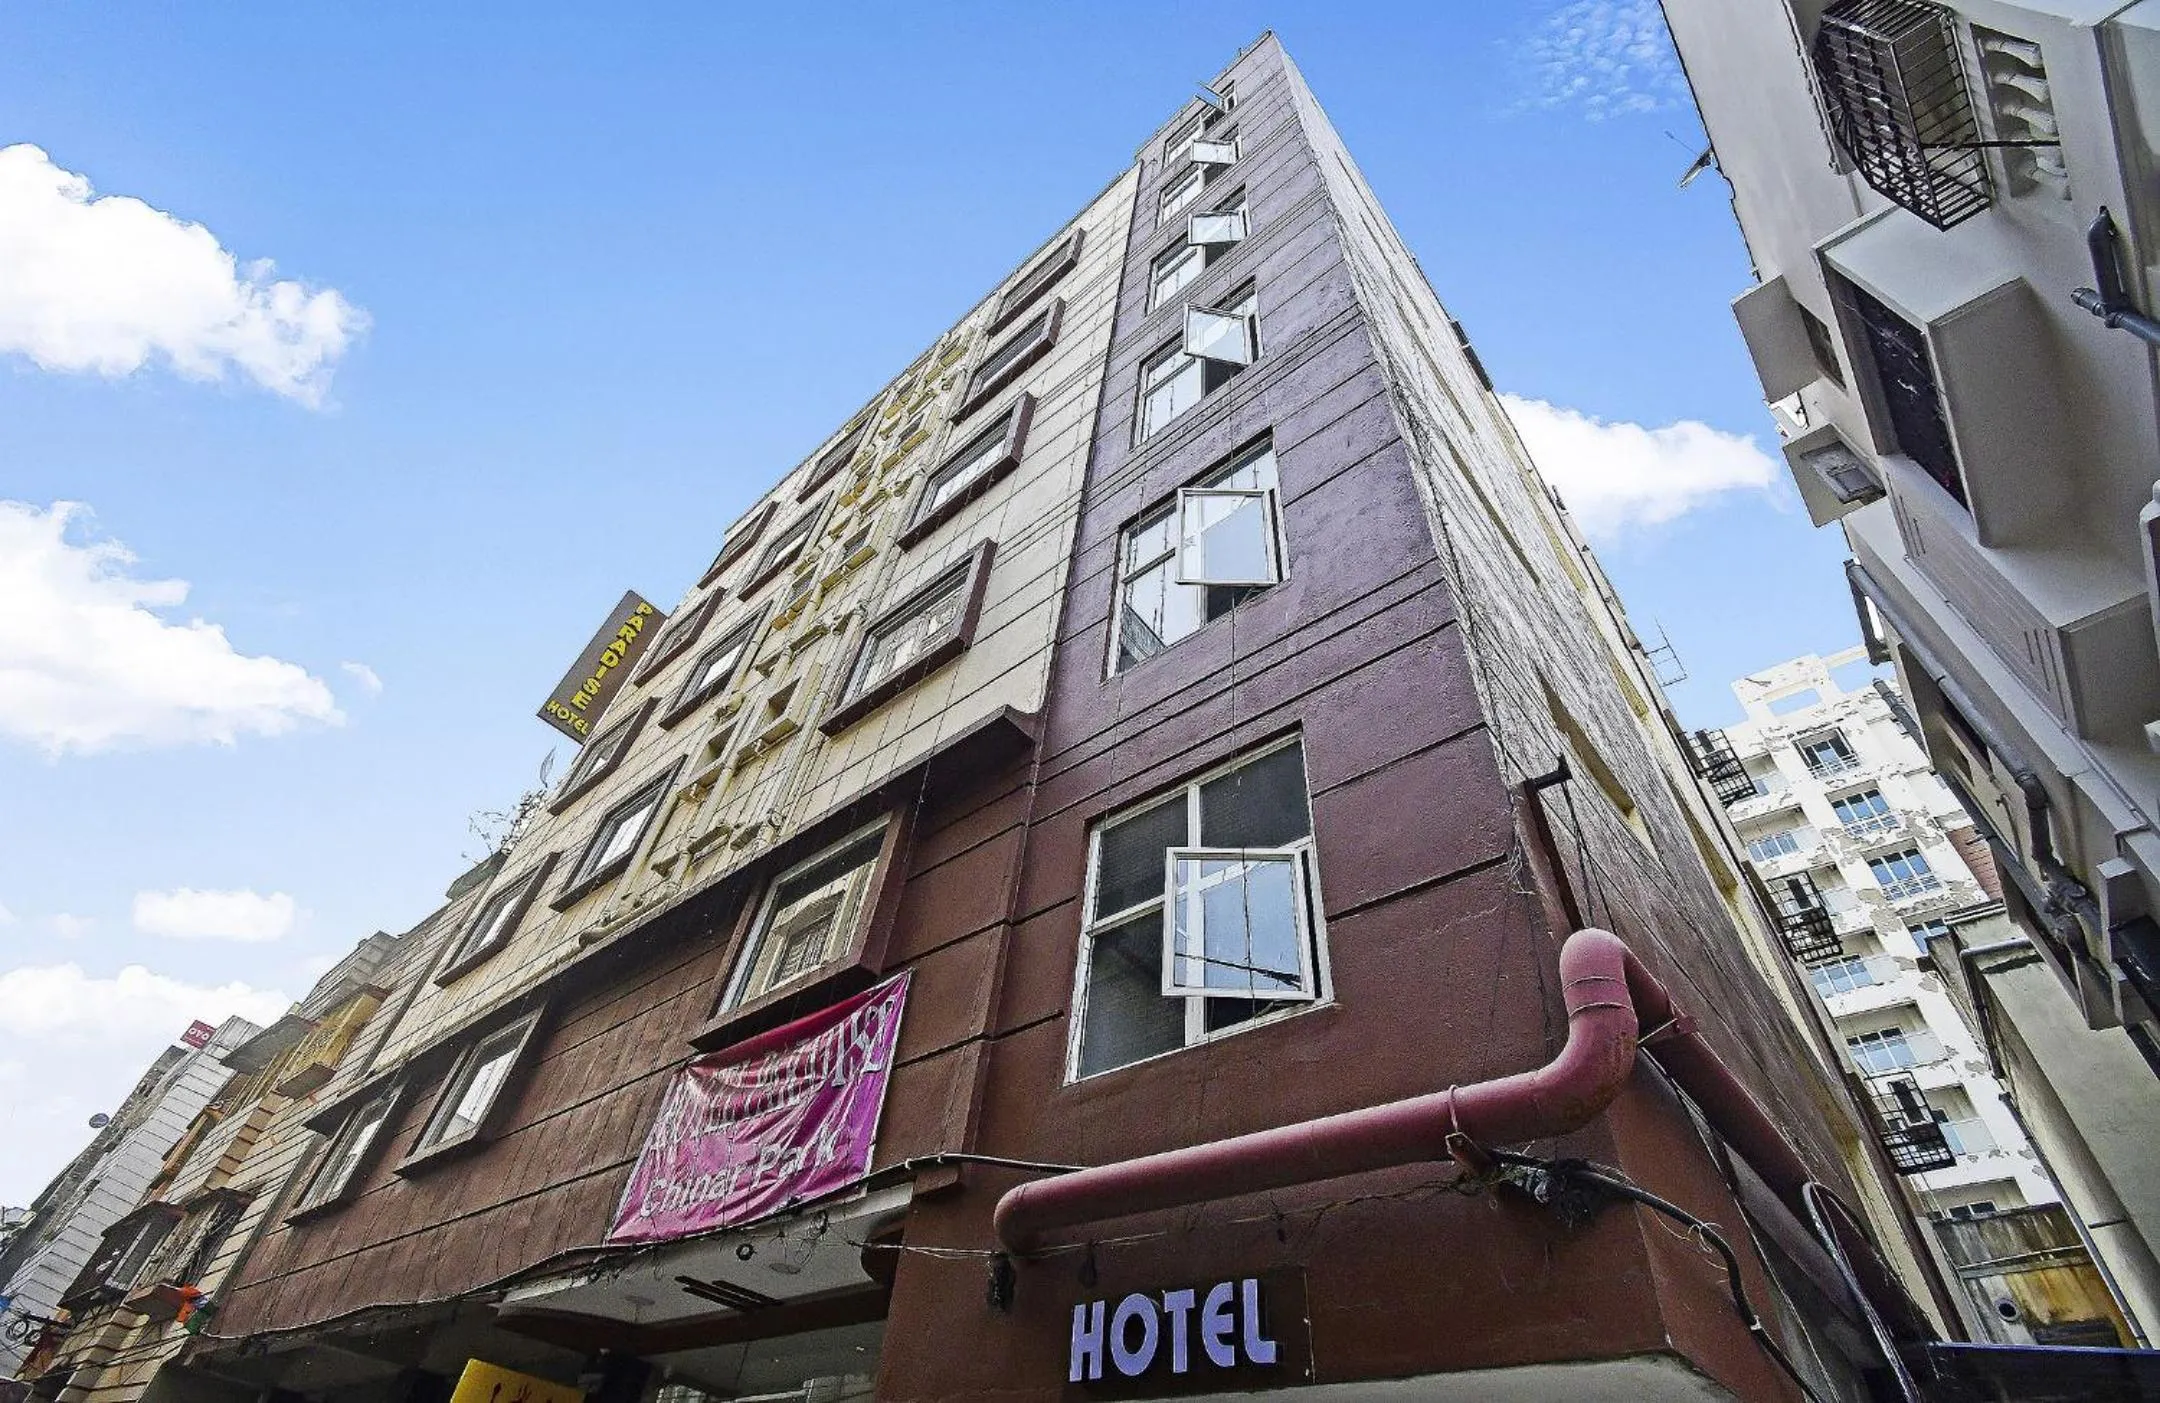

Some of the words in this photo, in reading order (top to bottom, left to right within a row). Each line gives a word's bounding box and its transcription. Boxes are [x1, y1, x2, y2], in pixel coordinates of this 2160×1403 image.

[572, 602, 653, 710] PARADISE
[546, 700, 589, 735] HOTEL
[188, 1027, 210, 1041] OYO
[758, 1126, 837, 1179] Park
[1069, 1279, 1277, 1382] HOTEL
